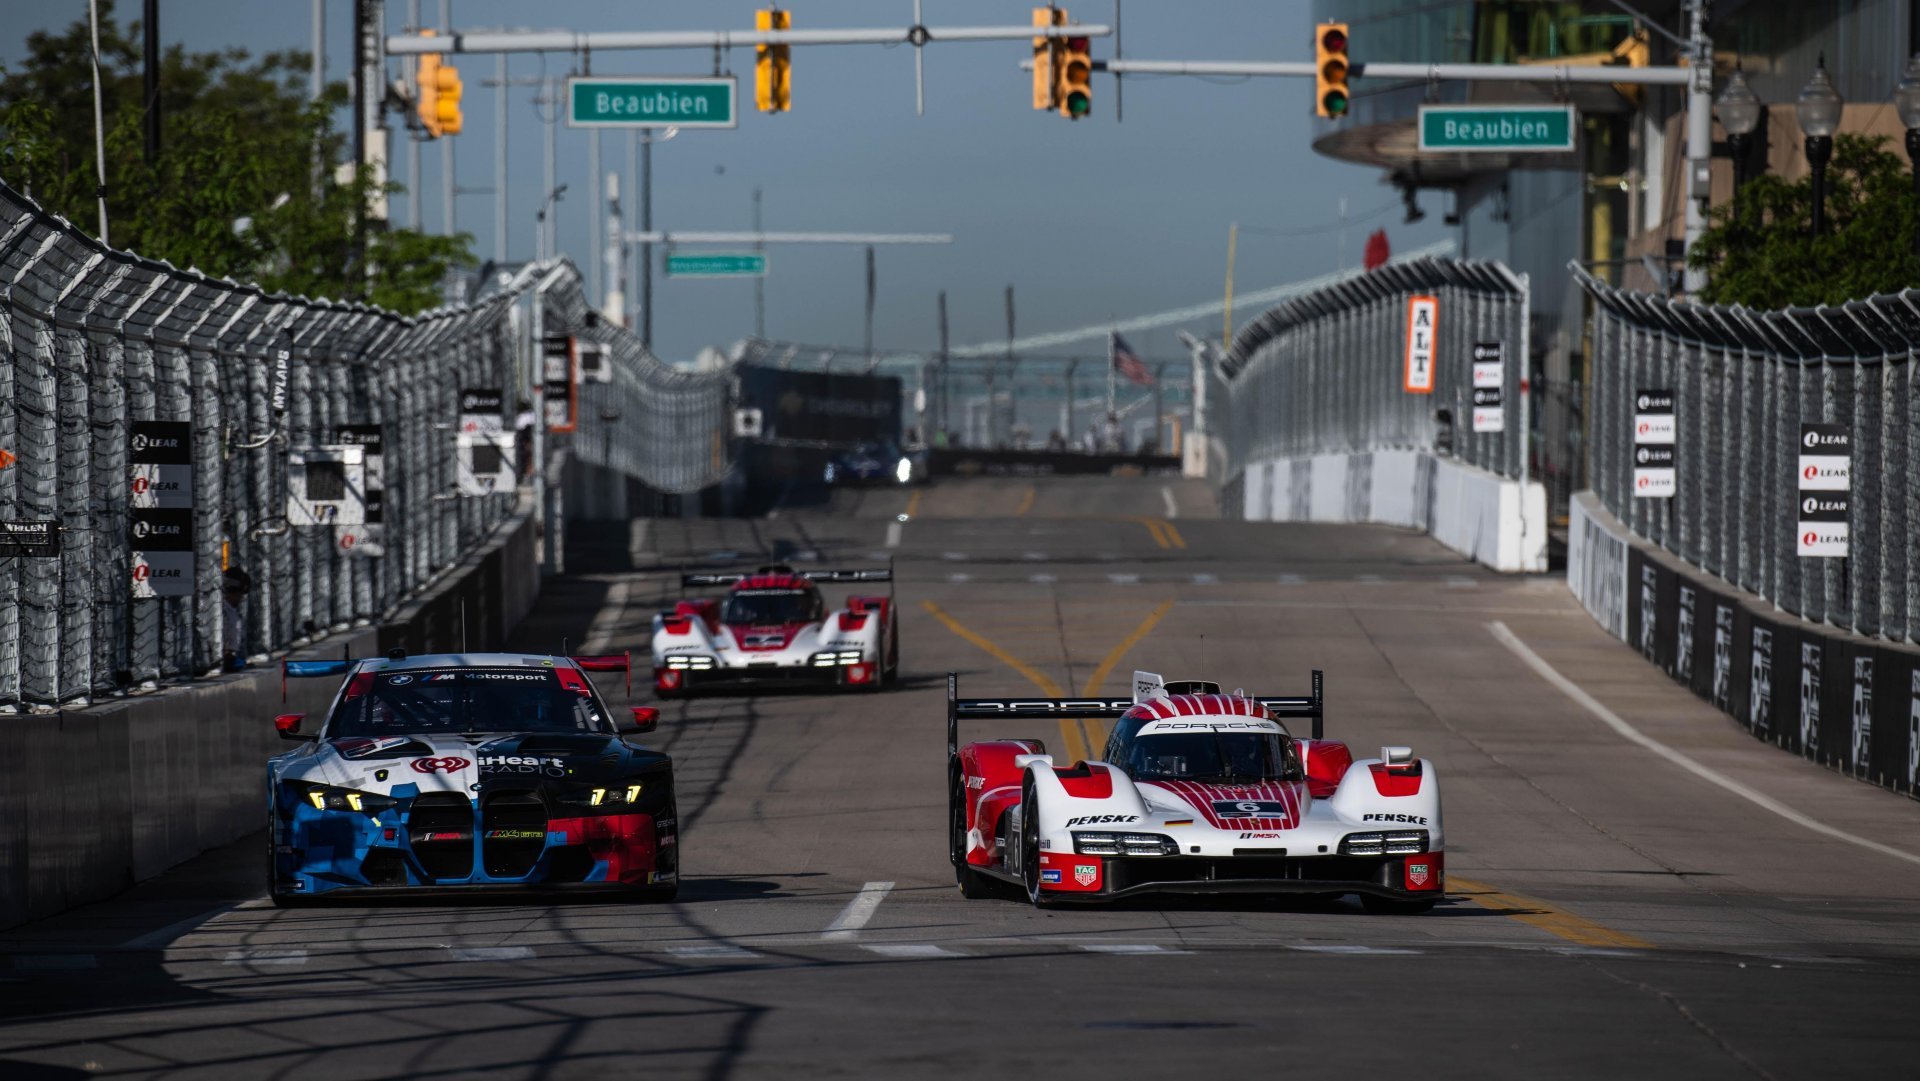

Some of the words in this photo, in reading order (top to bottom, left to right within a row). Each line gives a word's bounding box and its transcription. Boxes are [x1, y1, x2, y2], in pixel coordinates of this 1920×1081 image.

[596, 92, 708, 114] Beaubien
[1444, 118, 1548, 139] Beaubien
[272, 350, 289, 409] MYLAPS
[149, 439, 178, 448] LEAR
[1820, 434, 1849, 445] LEAR
[1821, 469, 1848, 478] LEAR
[1819, 501, 1848, 511] LEAR
[152, 525, 180, 534] LEAR
[1820, 535, 1848, 544] LEAR
[152, 569, 182, 578] LEAR
[465, 673, 548, 681] Motorsport
[1154, 722, 1277, 730] PORSCHE
[478, 755, 564, 768] iHeart
[478, 765, 565, 778] RADIO
[1235, 802, 1261, 812] 6
[1065, 815, 1140, 829] PENSKE
[1364, 813, 1428, 826] PENSKE
[1077, 866, 1095, 874] TAG
